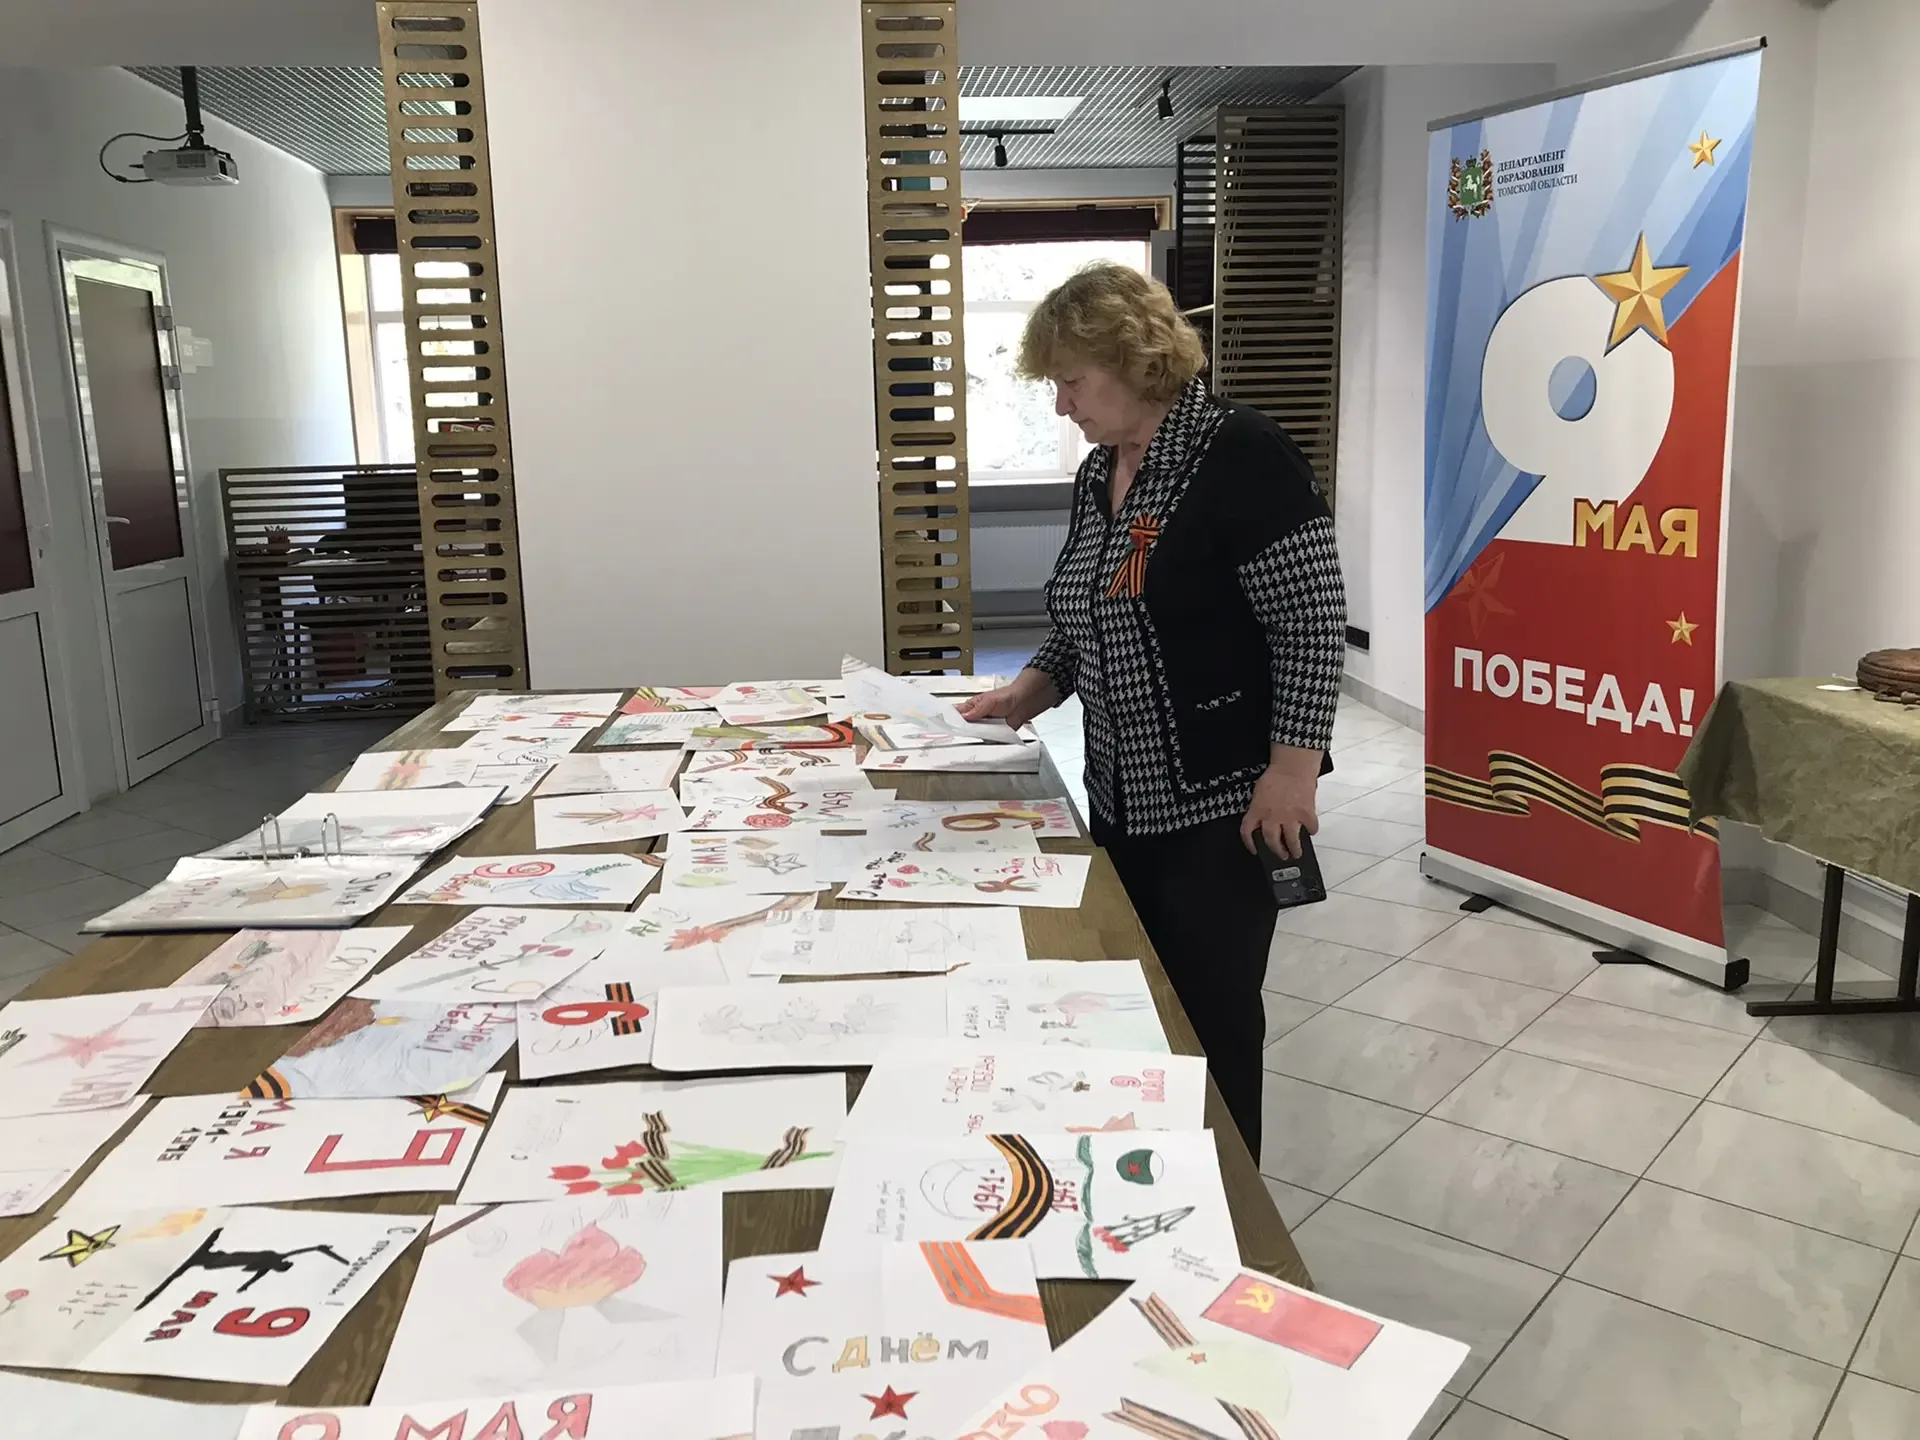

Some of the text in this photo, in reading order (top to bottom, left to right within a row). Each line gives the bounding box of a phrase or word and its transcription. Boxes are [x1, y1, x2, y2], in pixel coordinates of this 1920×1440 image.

[1497, 149, 1566, 173] ДЕПАРТАМЕНТ
[1497, 163, 1565, 184] ОБРАЗОВАНИЯ
[1497, 174, 1578, 197] ТОМСКОЙ ОБЛАСТИ
[1481, 274, 1676, 546] 9
[1573, 497, 1699, 558] МАЯ
[1453, 646, 1695, 737] ПОБЕДА!
[410, 916, 492, 960] ПОБЕДА
[144, 1290, 218, 1343] МАЯ
